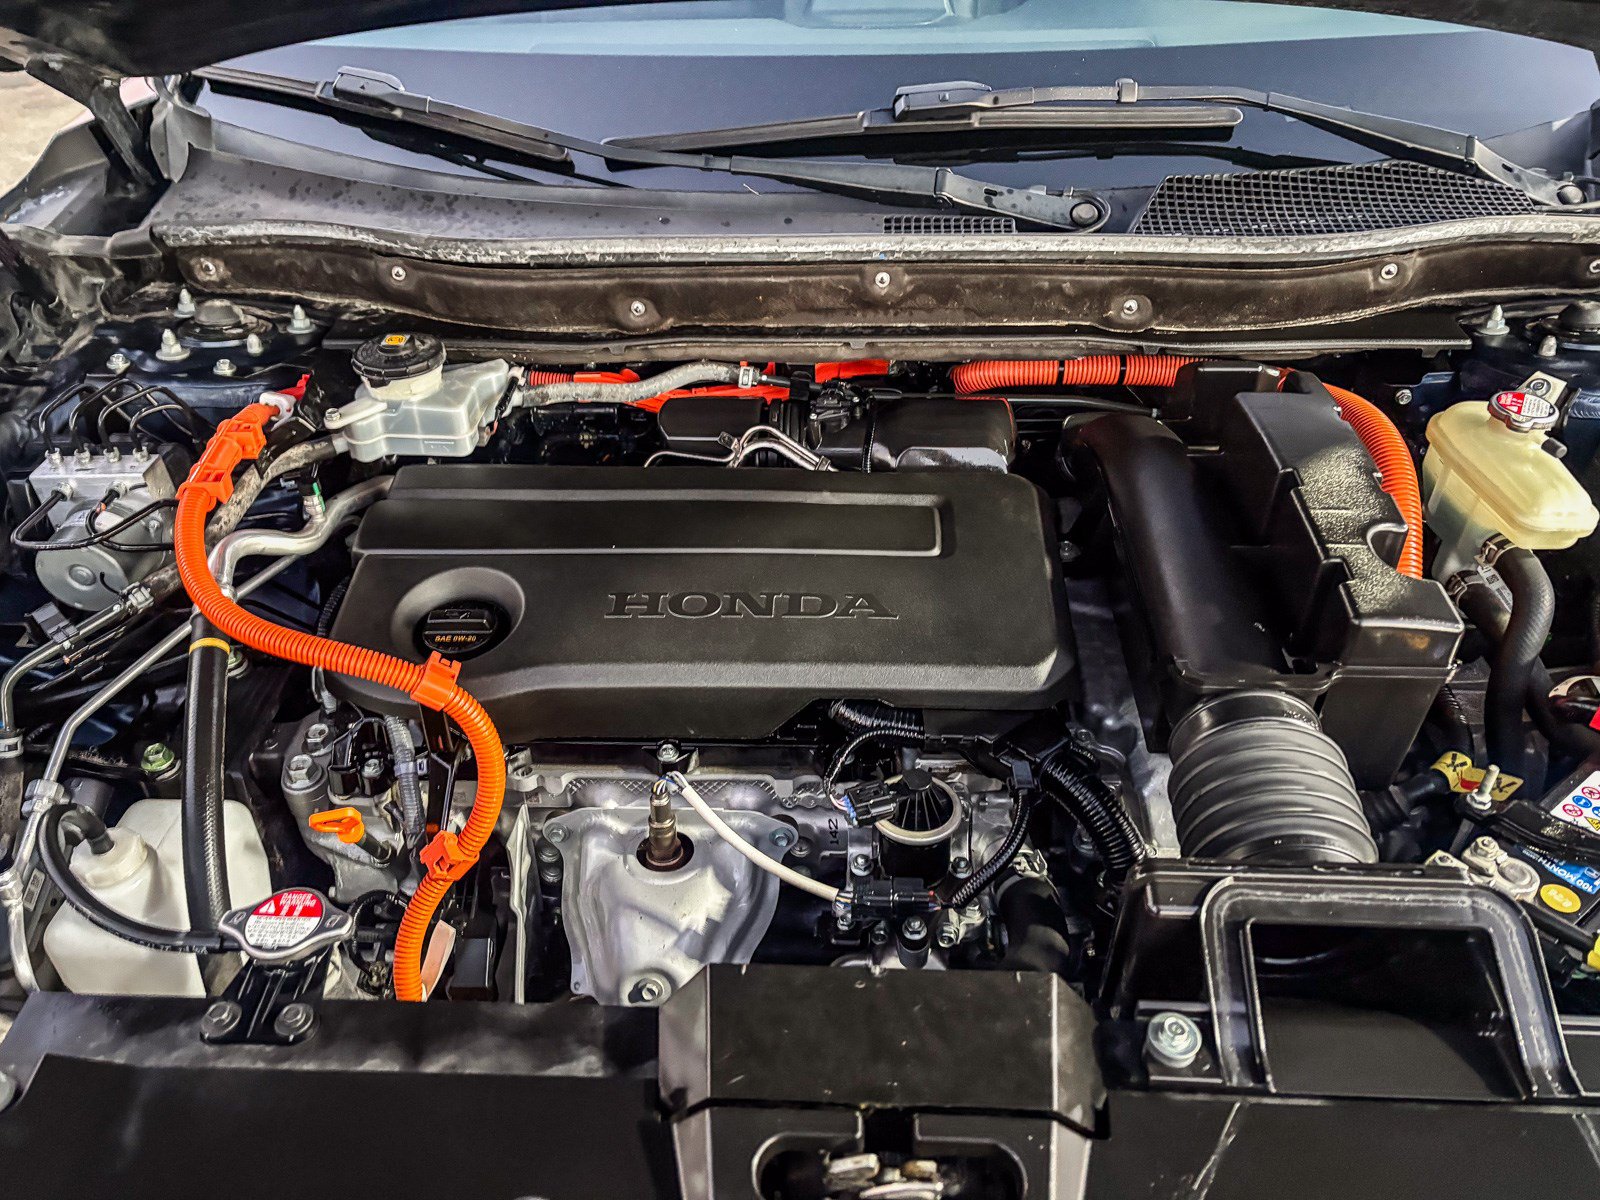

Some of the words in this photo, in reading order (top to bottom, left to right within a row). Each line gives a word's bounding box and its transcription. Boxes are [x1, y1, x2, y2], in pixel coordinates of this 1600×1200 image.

[604, 592, 899, 619] HONDA
[434, 635, 452, 643] SAE
[828, 818, 839, 845] 142
[1538, 857, 1577, 882] MONTH
[1576, 879, 1593, 893] 100
[279, 898, 317, 908] WARNING
[281, 892, 313, 901] DANGER
